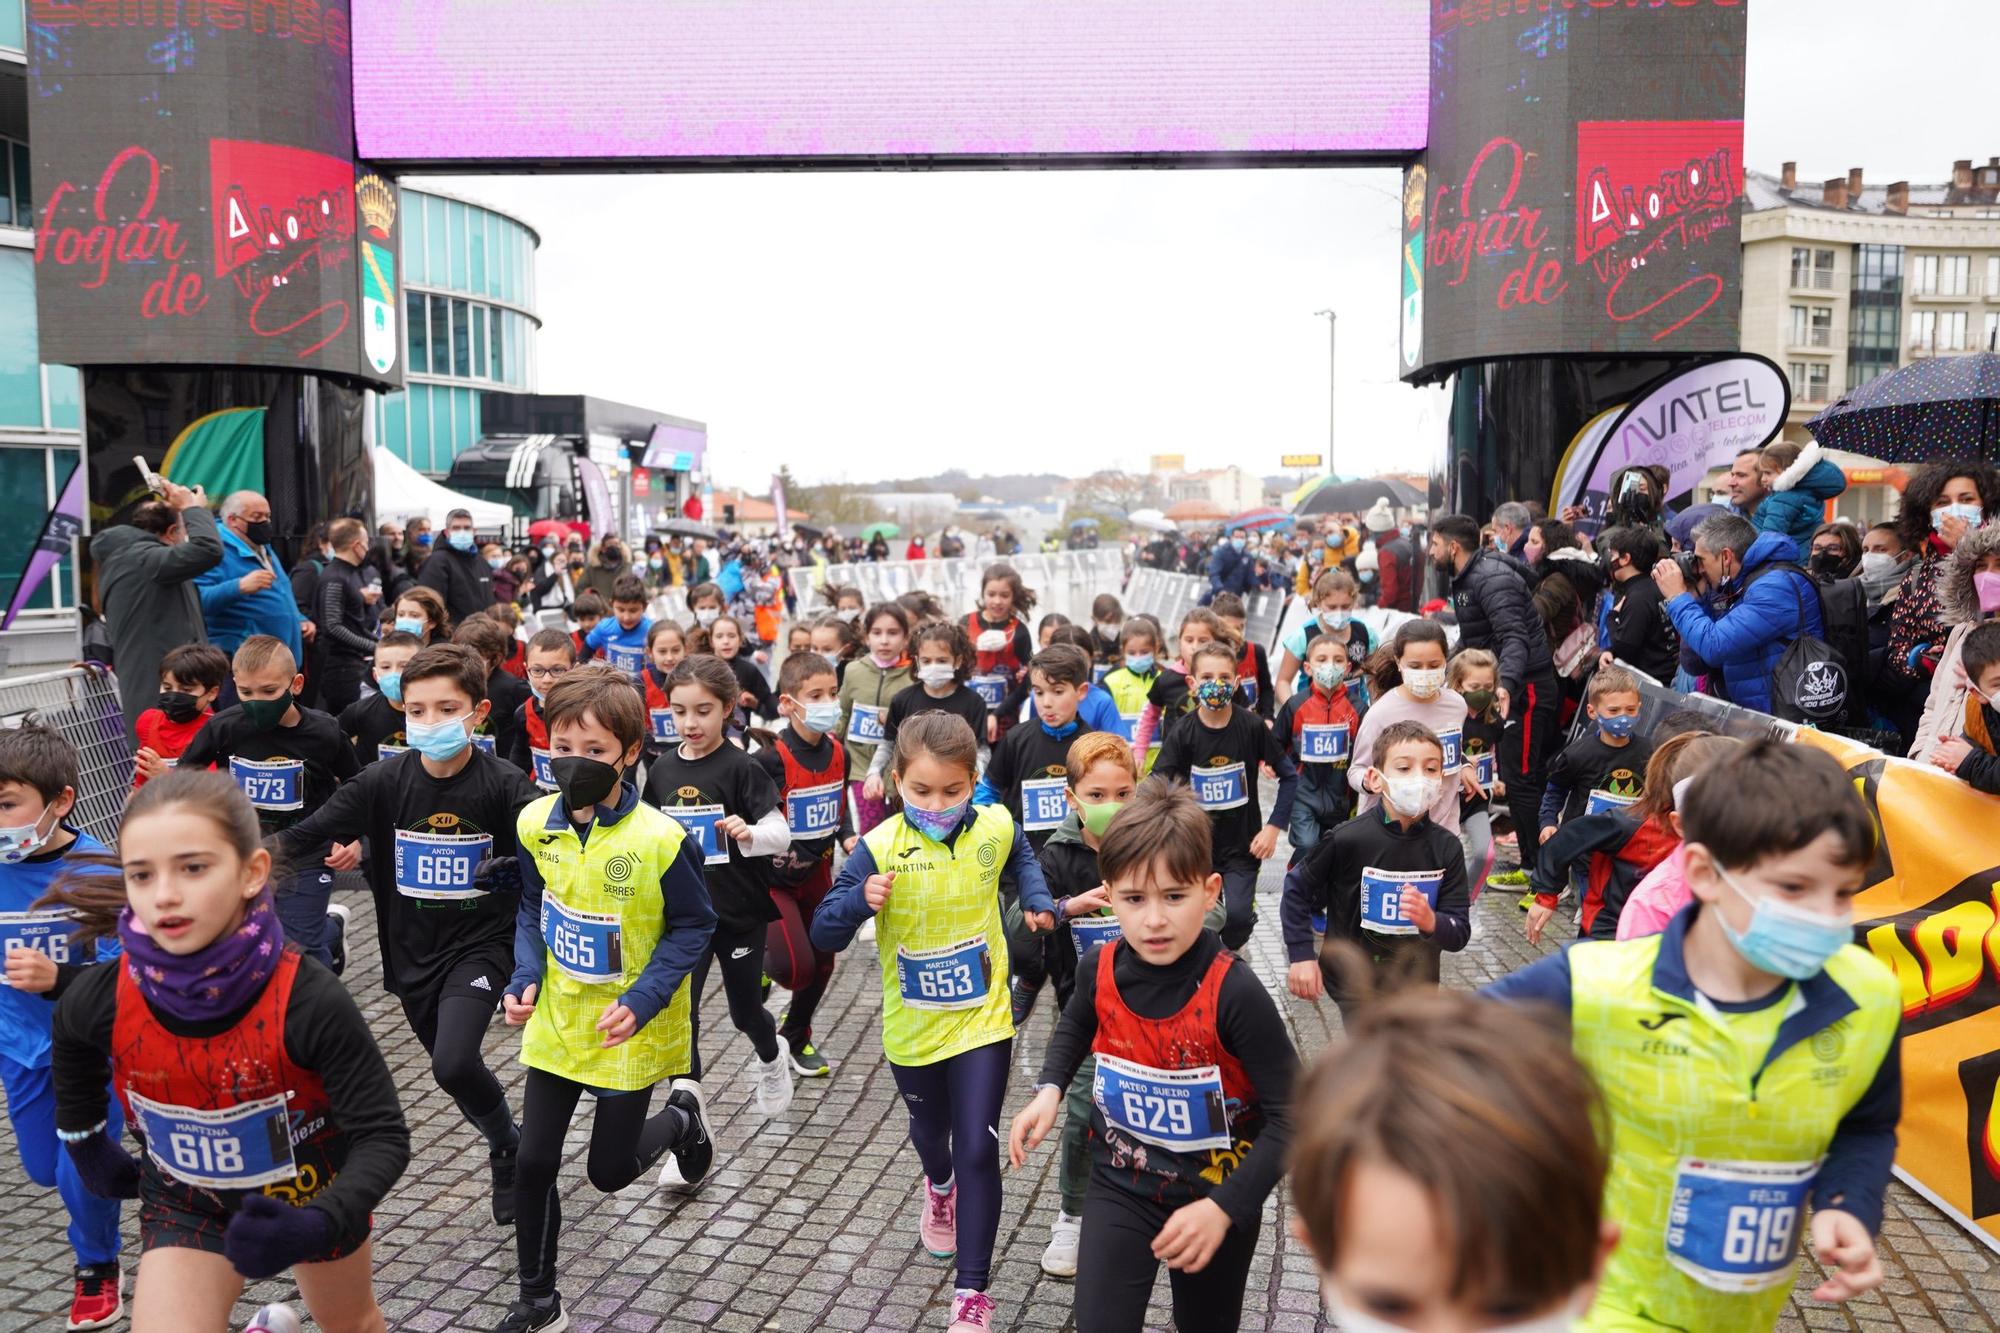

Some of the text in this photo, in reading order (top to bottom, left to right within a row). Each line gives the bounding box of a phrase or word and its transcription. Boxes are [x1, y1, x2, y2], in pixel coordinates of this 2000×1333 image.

[141, 264, 208, 319] de
[1498, 253, 1568, 310] de
[1622, 378, 1766, 462] AVATEL
[617, 655, 635, 671] 615
[1314, 736, 1338, 755] 641
[245, 777, 285, 800] 673
[1202, 780, 1233, 801] 667
[435, 816, 453, 825] XII
[806, 800, 838, 828] 620
[432, 847, 456, 855] ANTÓN
[397, 868, 404, 879] 10
[418, 855, 469, 885] 669
[888, 861, 935, 874] MARTINA
[603, 883, 635, 896] SERRES
[554, 924, 595, 968] 655
[925, 959, 959, 970] MARTINA
[918, 964, 973, 997] 653
[1118, 1079, 1190, 1098] MATEO SUEIRO
[1122, 1092, 1192, 1135] 629
[175, 1122, 230, 1137] MARTINA
[169, 1132, 245, 1173] 618
[1668, 1187, 1693, 1248] SUB 10
[1722, 1205, 1796, 1264] 619
